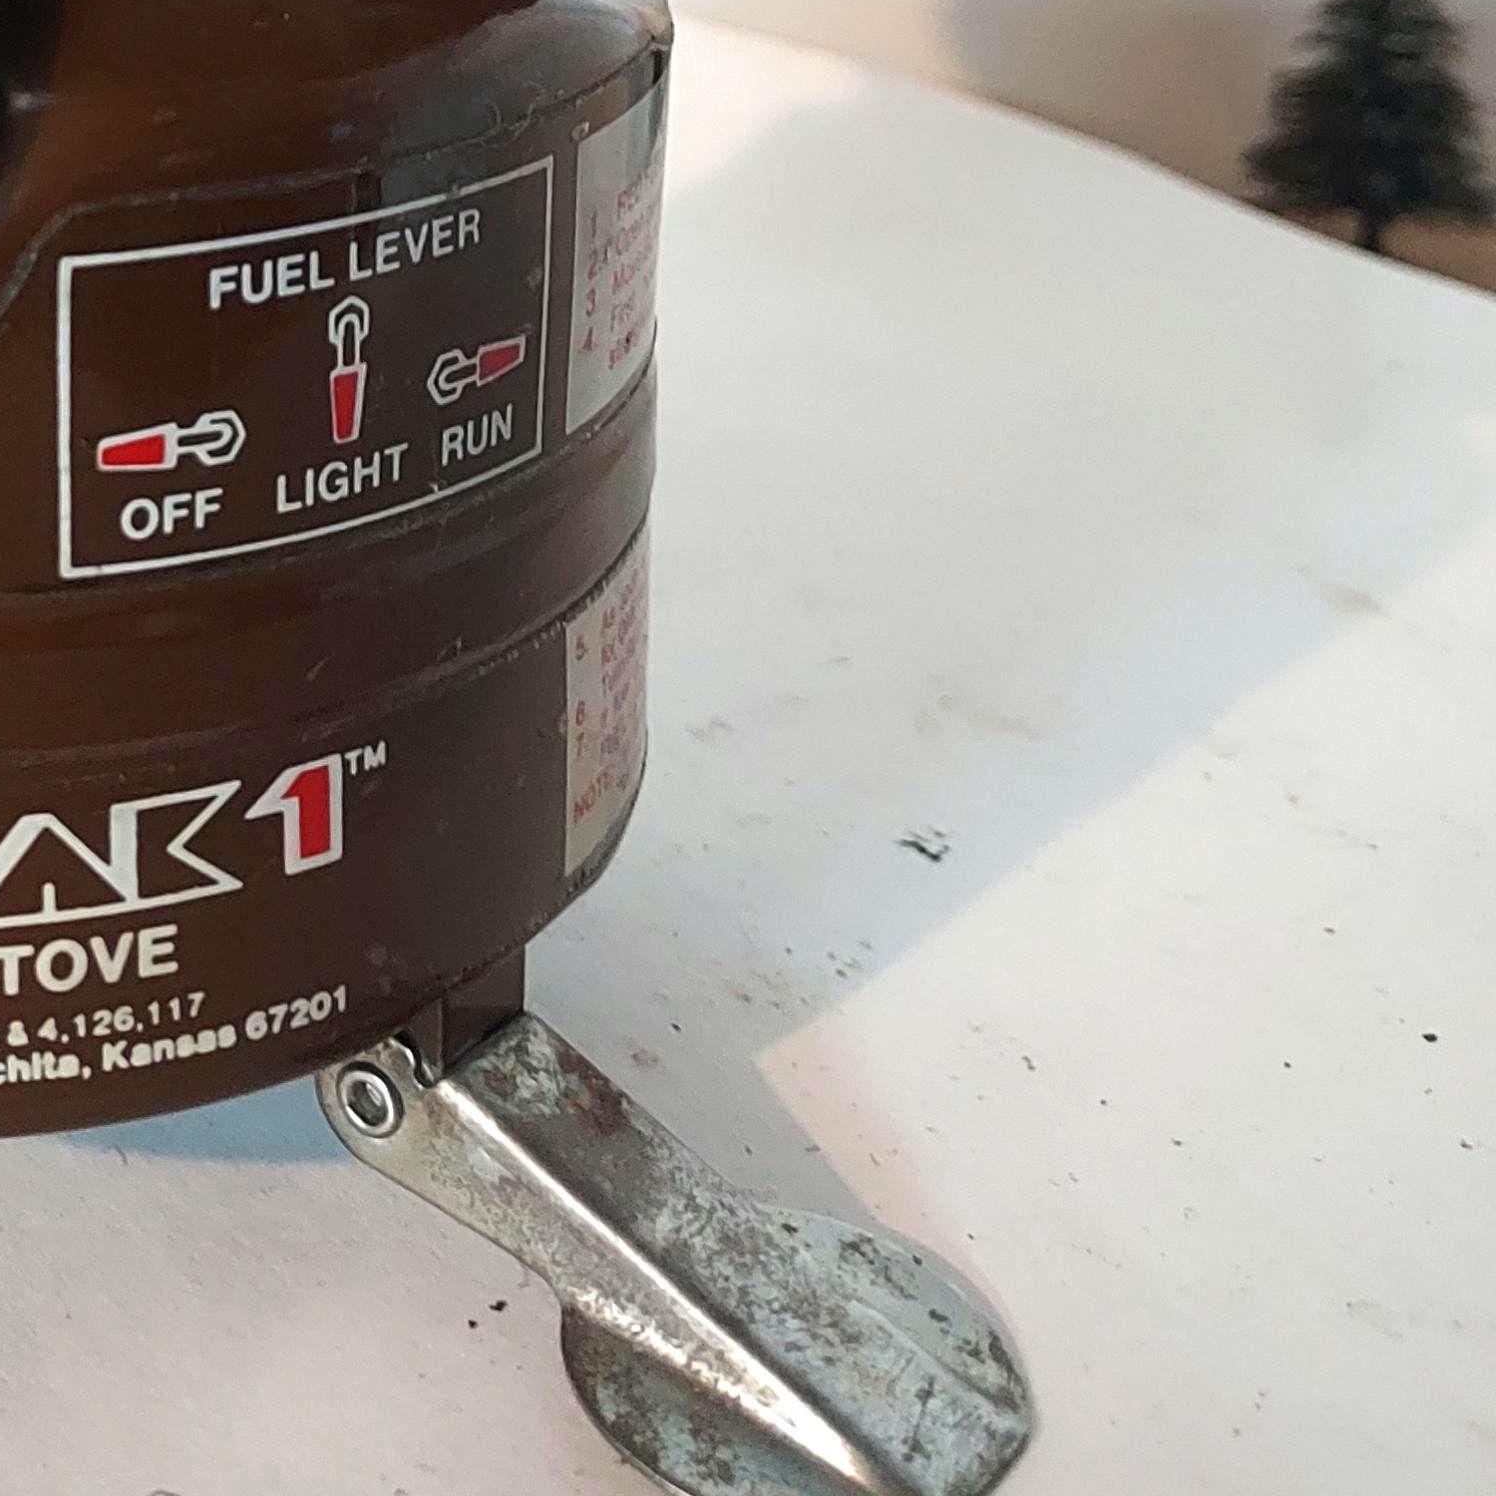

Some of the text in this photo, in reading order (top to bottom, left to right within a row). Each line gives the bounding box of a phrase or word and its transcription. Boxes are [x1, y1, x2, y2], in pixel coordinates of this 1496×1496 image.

[209, 209, 481, 309] FUEL LEVER
[441, 404, 514, 465] RUN
[277, 444, 408, 513] LIGHT
[120, 489, 224, 540] OFF
[244, 754, 343, 875] 1
[6, 1021, 30, 1048] &
[102, 1022, 238, 1072] Kansas
[244, 985, 349, 1041] 67201
